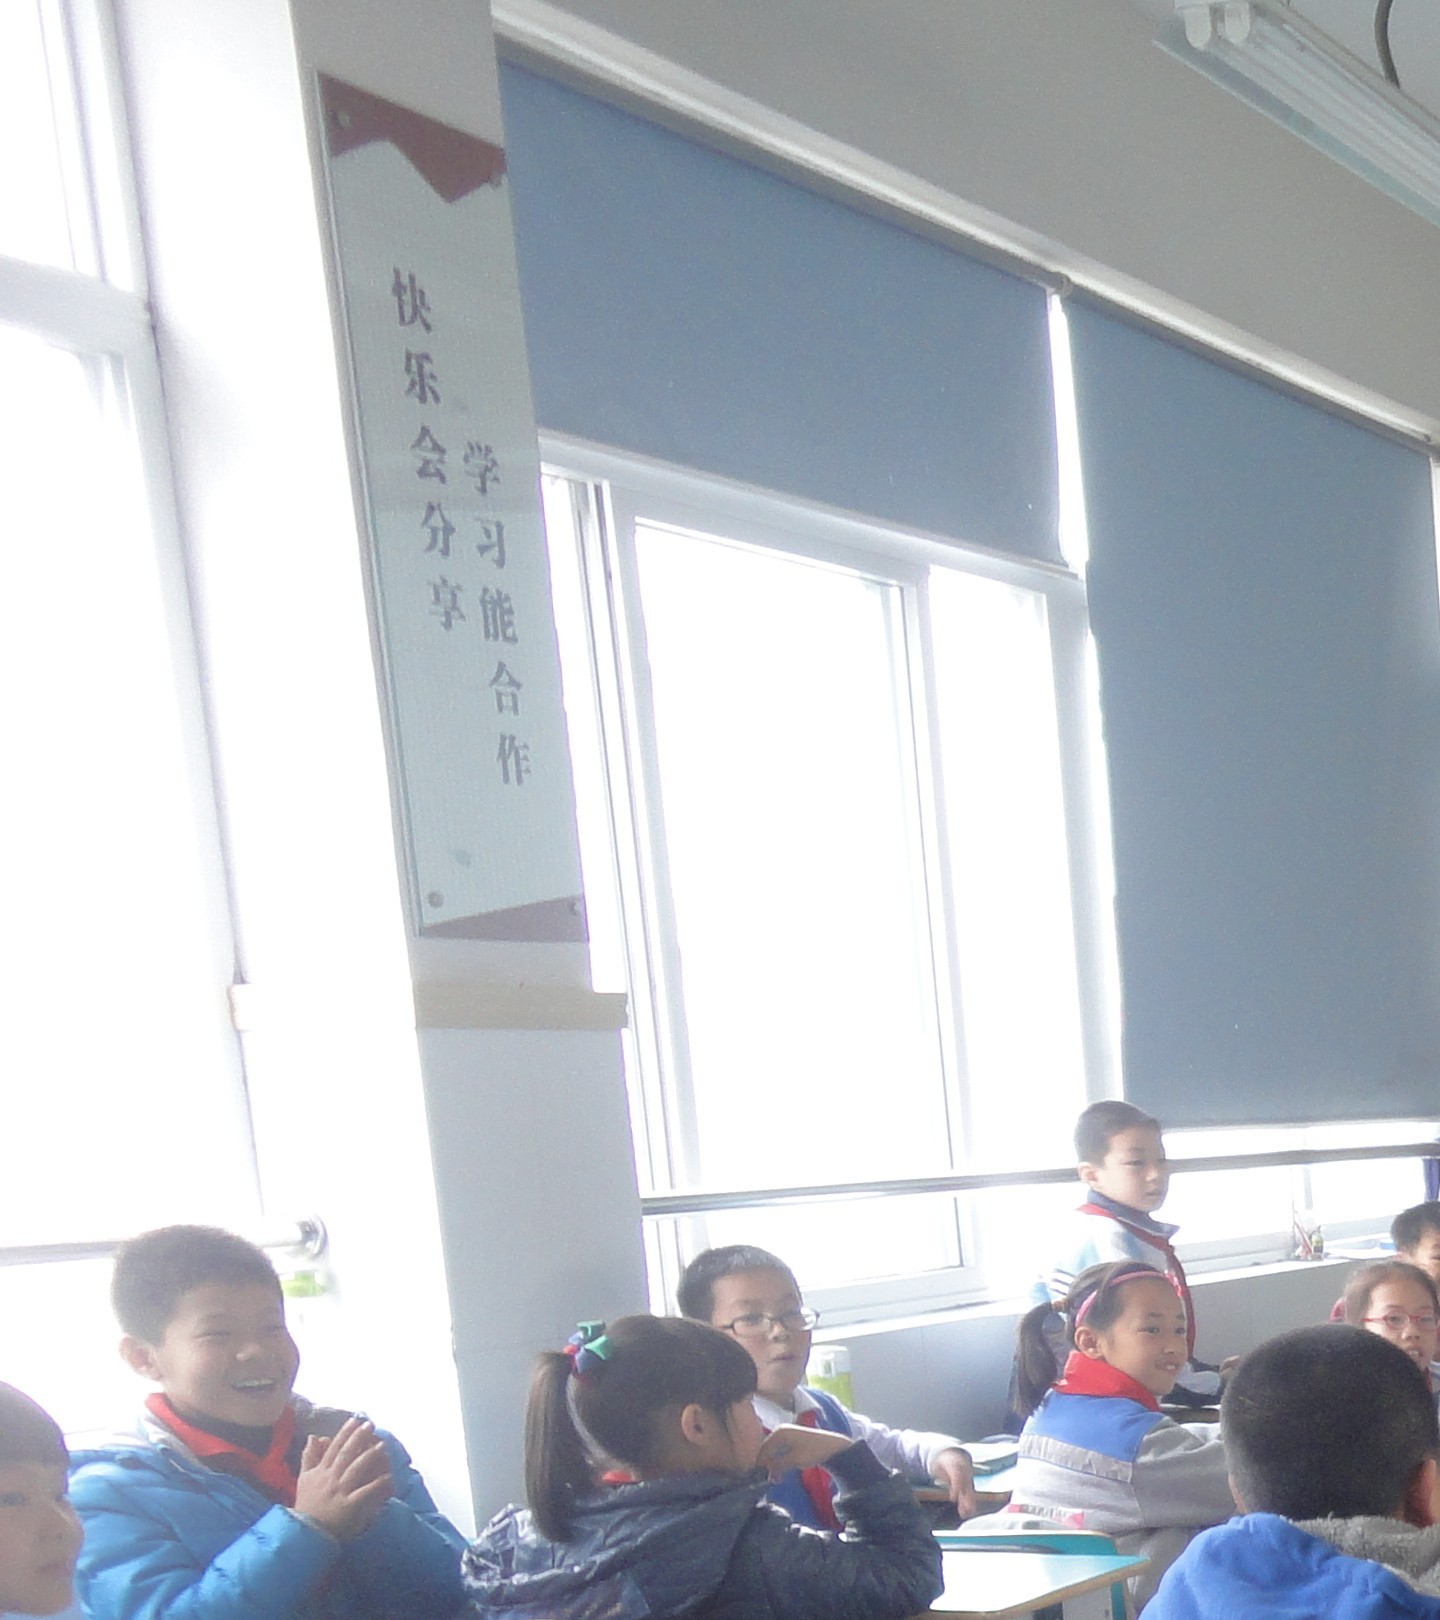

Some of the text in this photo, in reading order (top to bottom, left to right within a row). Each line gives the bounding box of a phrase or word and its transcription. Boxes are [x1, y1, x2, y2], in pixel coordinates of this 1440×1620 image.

[392, 265, 466, 631] 快乐会分享
[463, 440, 532, 787] 学习能合作
